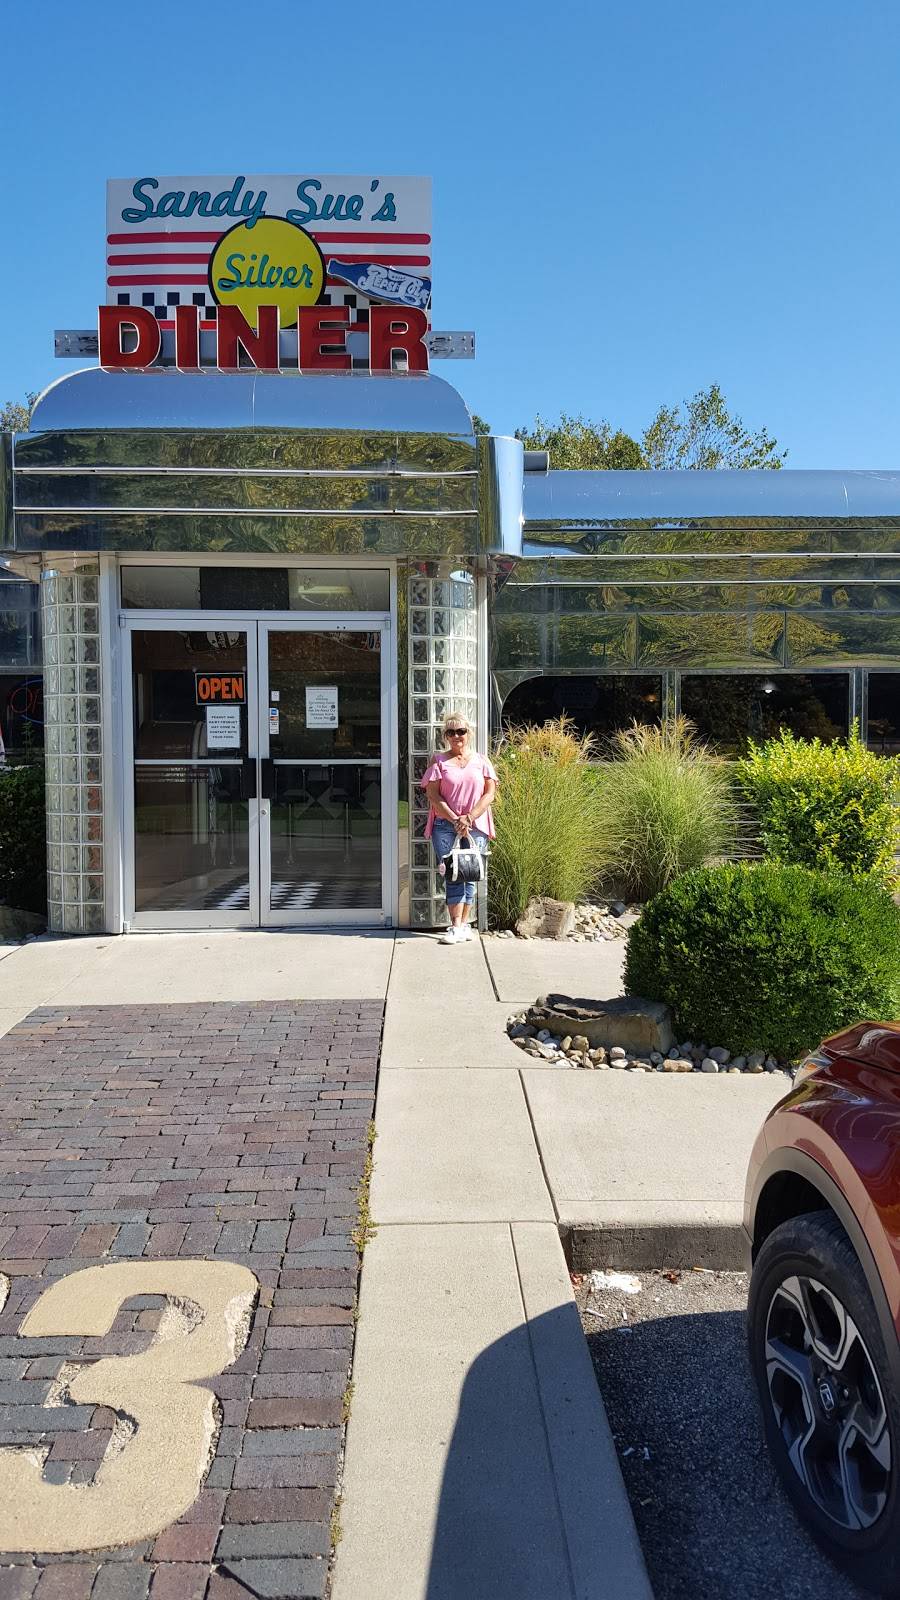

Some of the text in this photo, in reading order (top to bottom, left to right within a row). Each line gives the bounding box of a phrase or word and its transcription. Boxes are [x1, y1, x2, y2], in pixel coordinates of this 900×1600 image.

[121, 175, 398, 229] Sandy Sue's
[217, 253, 313, 291] Silver
[98, 304, 430, 374] DINER
[198, 677, 244, 700] OPEN
